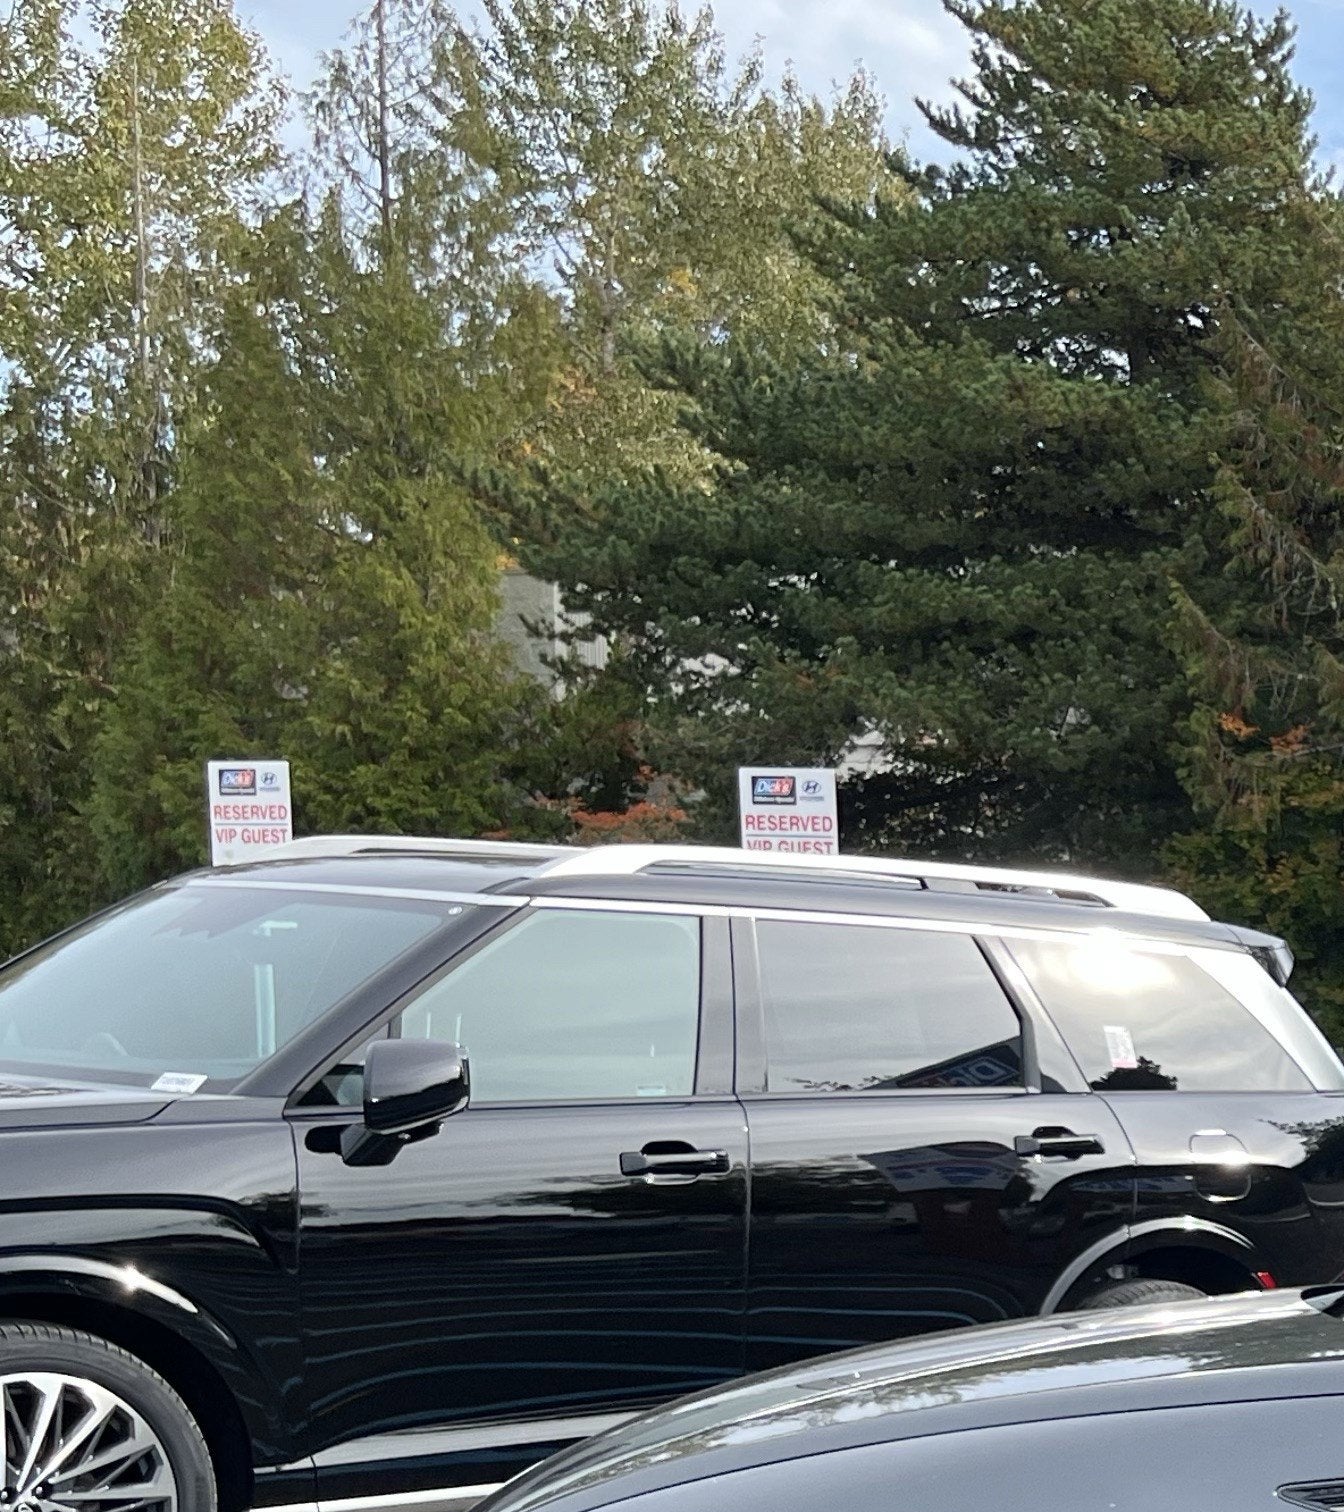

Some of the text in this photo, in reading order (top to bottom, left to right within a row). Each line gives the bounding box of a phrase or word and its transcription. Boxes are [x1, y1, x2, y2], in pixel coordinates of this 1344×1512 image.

[213, 804, 288, 820] RESERVED
[745, 814, 833, 832] RESERVED
[216, 828, 288, 844] VIP GUEST
[746, 839, 834, 855] VIP GUEST
